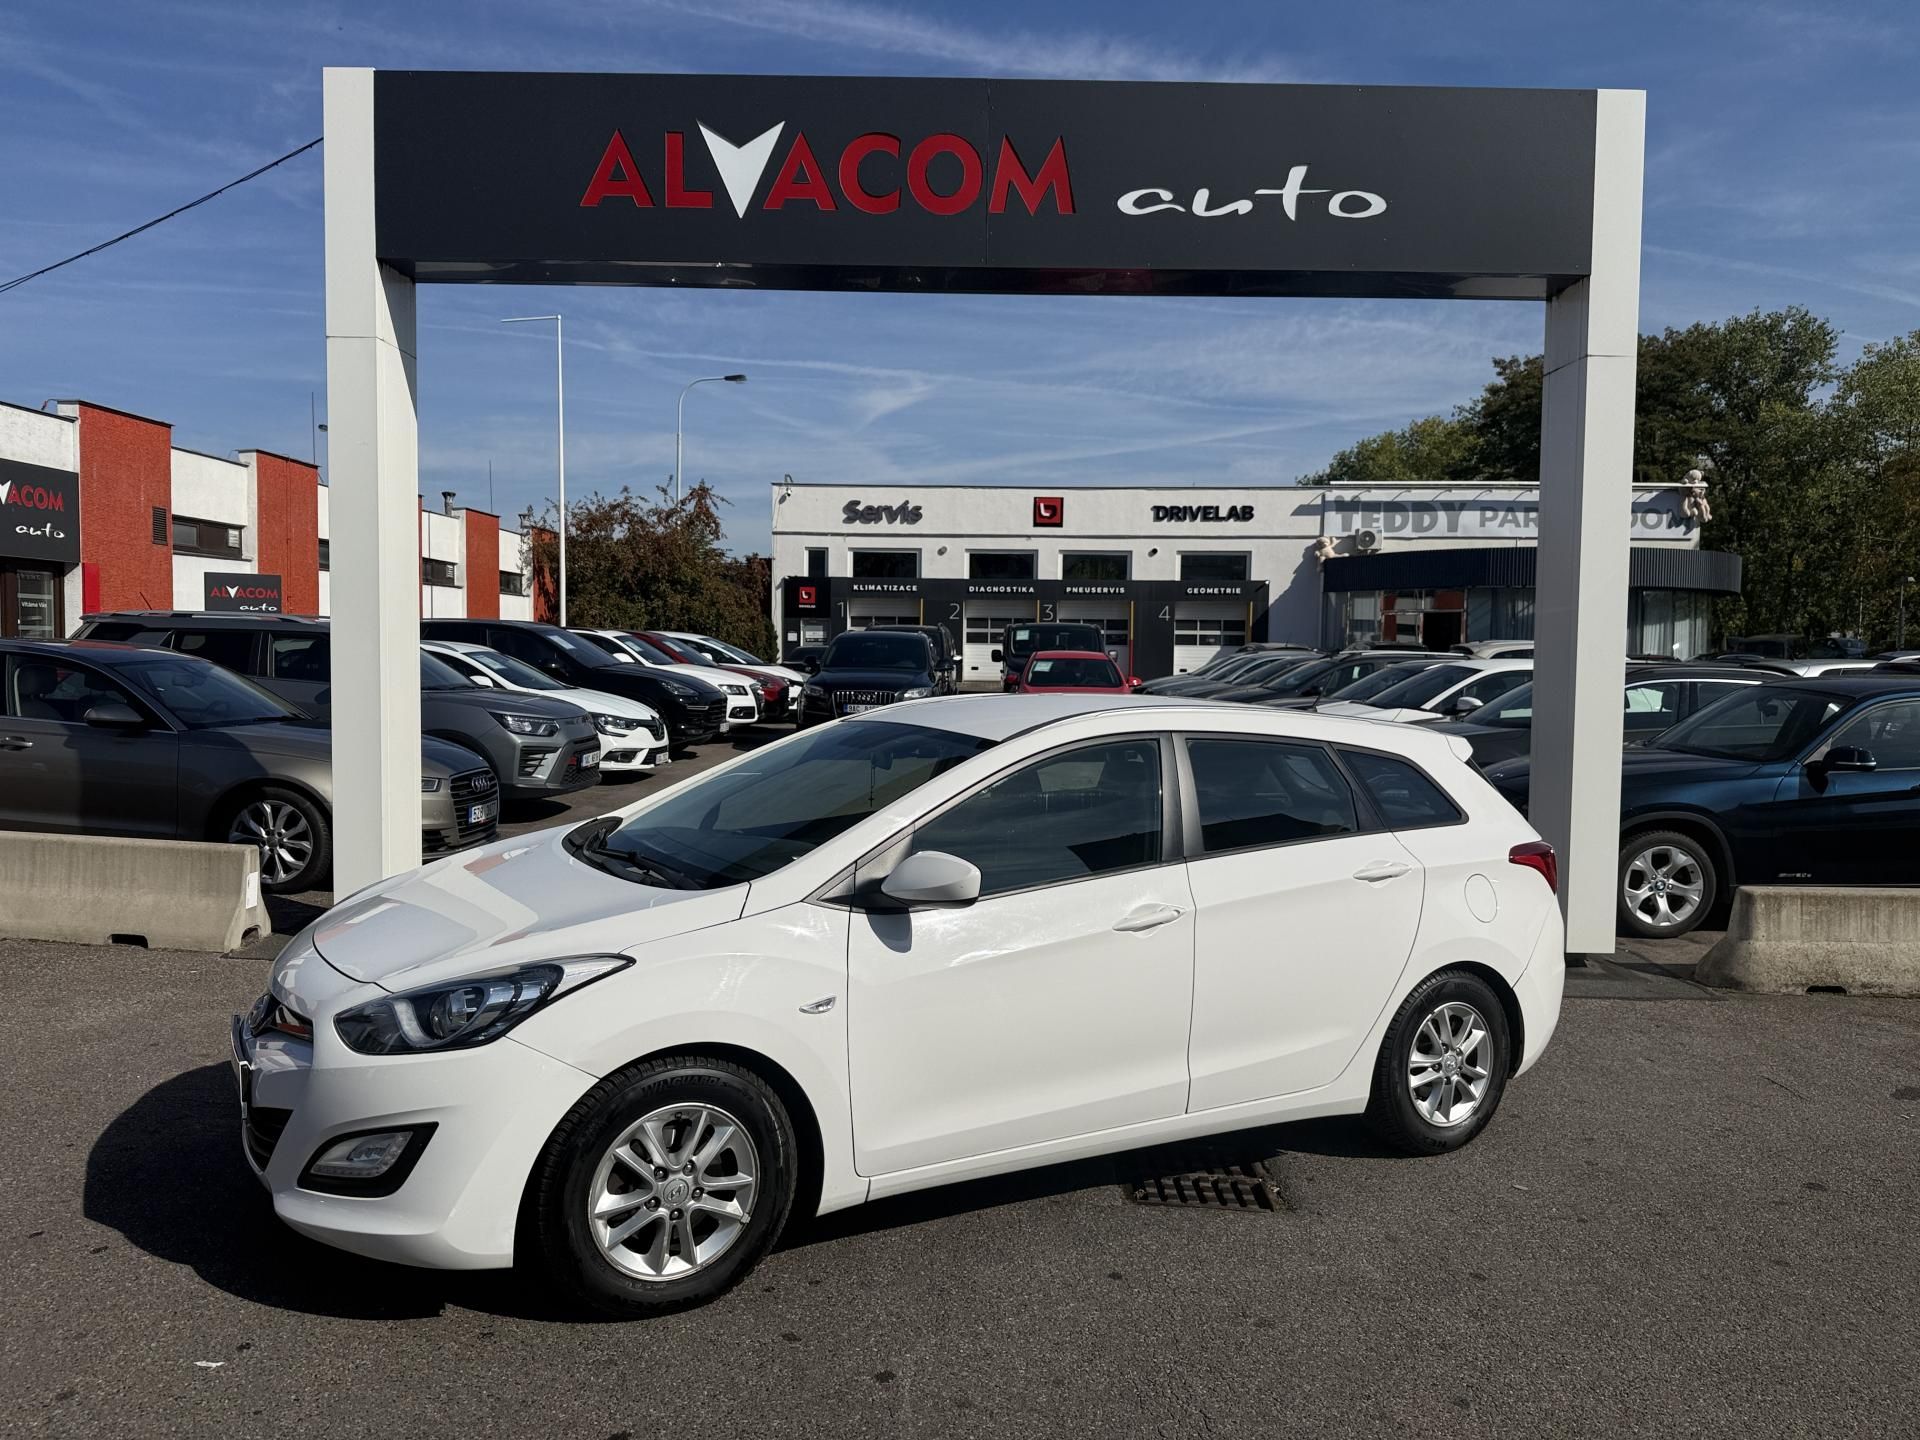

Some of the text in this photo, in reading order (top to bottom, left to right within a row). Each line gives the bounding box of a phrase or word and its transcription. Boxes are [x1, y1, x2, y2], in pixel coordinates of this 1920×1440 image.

[580, 118, 1388, 222] ALVACOM auto
[842, 499, 923, 525] Servis
[1150, 505, 1254, 522] DRIVELAB
[1334, 495, 1466, 533] TEDDY
[1479, 505, 1539, 529] PAR
[15, 523, 65, 538] auto
[210, 585, 278, 599] ALVACOM
[853, 584, 918, 592] KLIMATIZACE
[239, 603, 278, 611] auto
[836, 601, 844, 618] 1
[949, 603, 960, 619] 2
[1042, 604, 1054, 620] 3
[1158, 605, 1171, 621] 4
